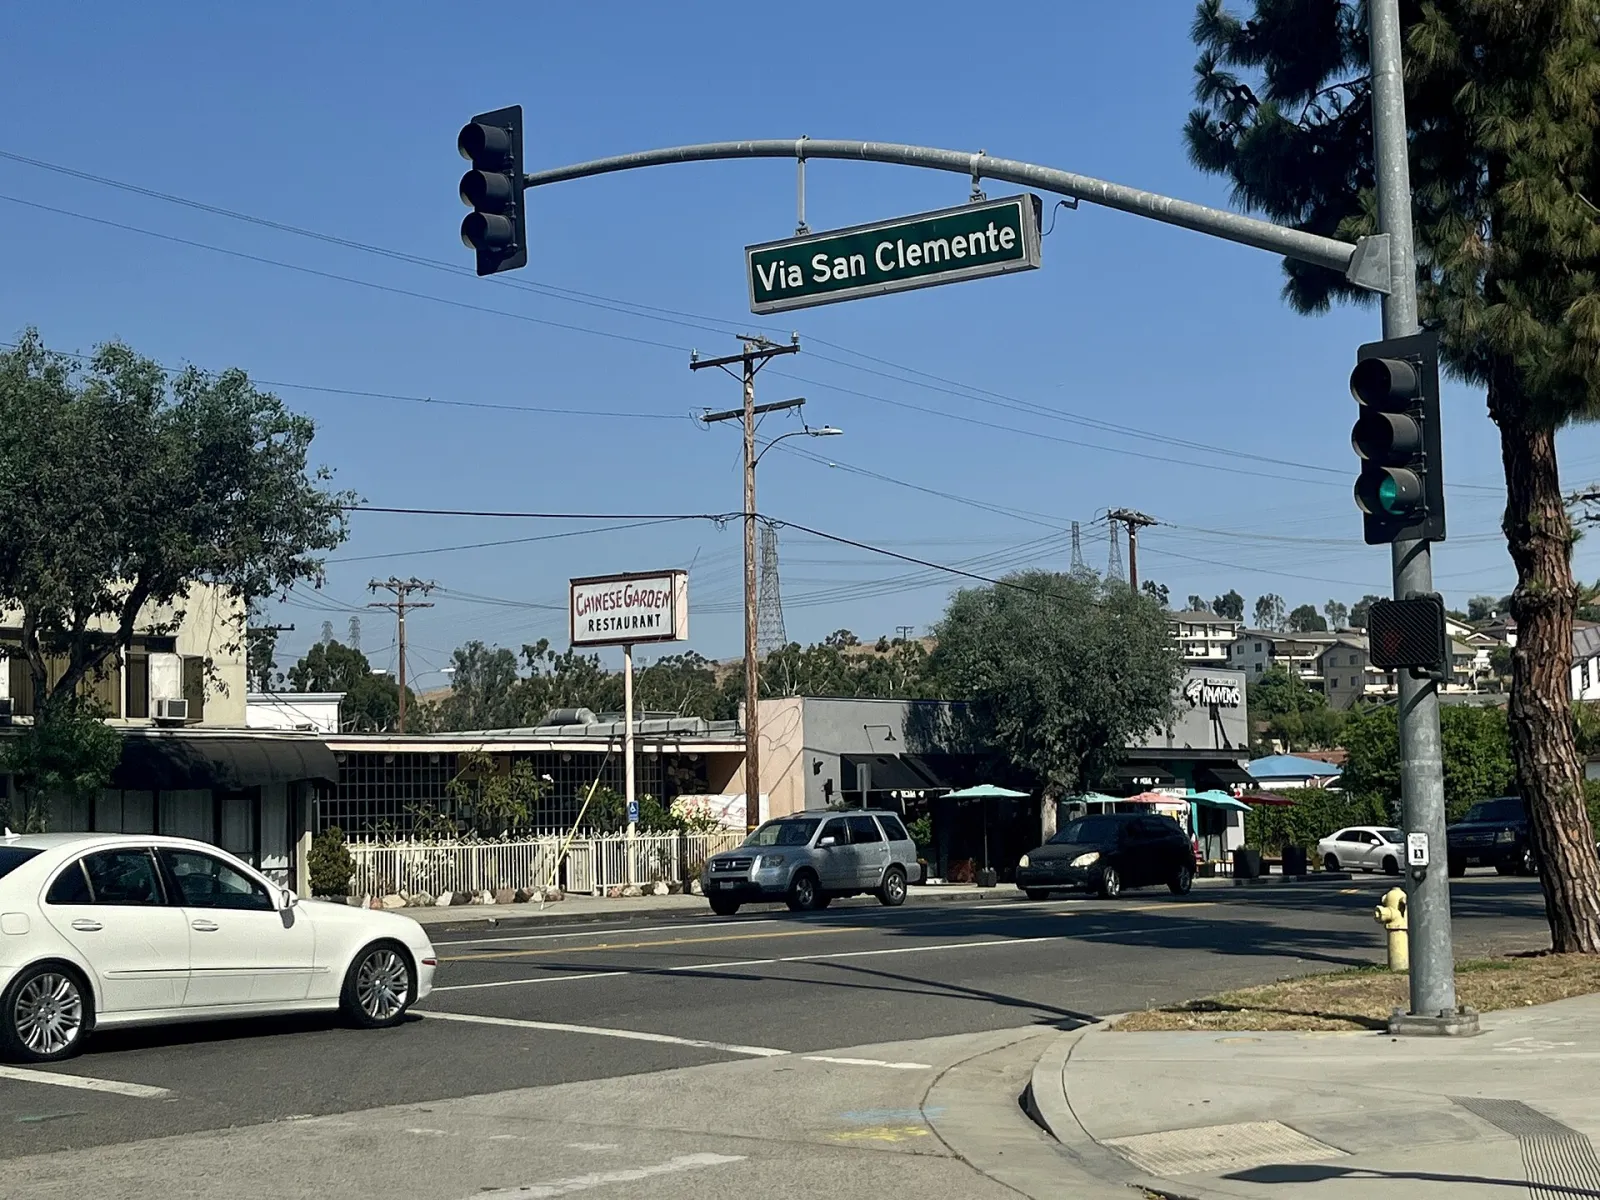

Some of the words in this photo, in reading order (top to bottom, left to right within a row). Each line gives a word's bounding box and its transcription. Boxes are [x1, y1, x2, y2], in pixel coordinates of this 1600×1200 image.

[756, 261, 803, 291] Via
[811, 254, 866, 283] San
[875, 221, 1016, 272] Clemente
[576, 589, 622, 617] CHINESE
[623, 584, 671, 609] GARDEN
[588, 613, 661, 632] RESTAURANT
